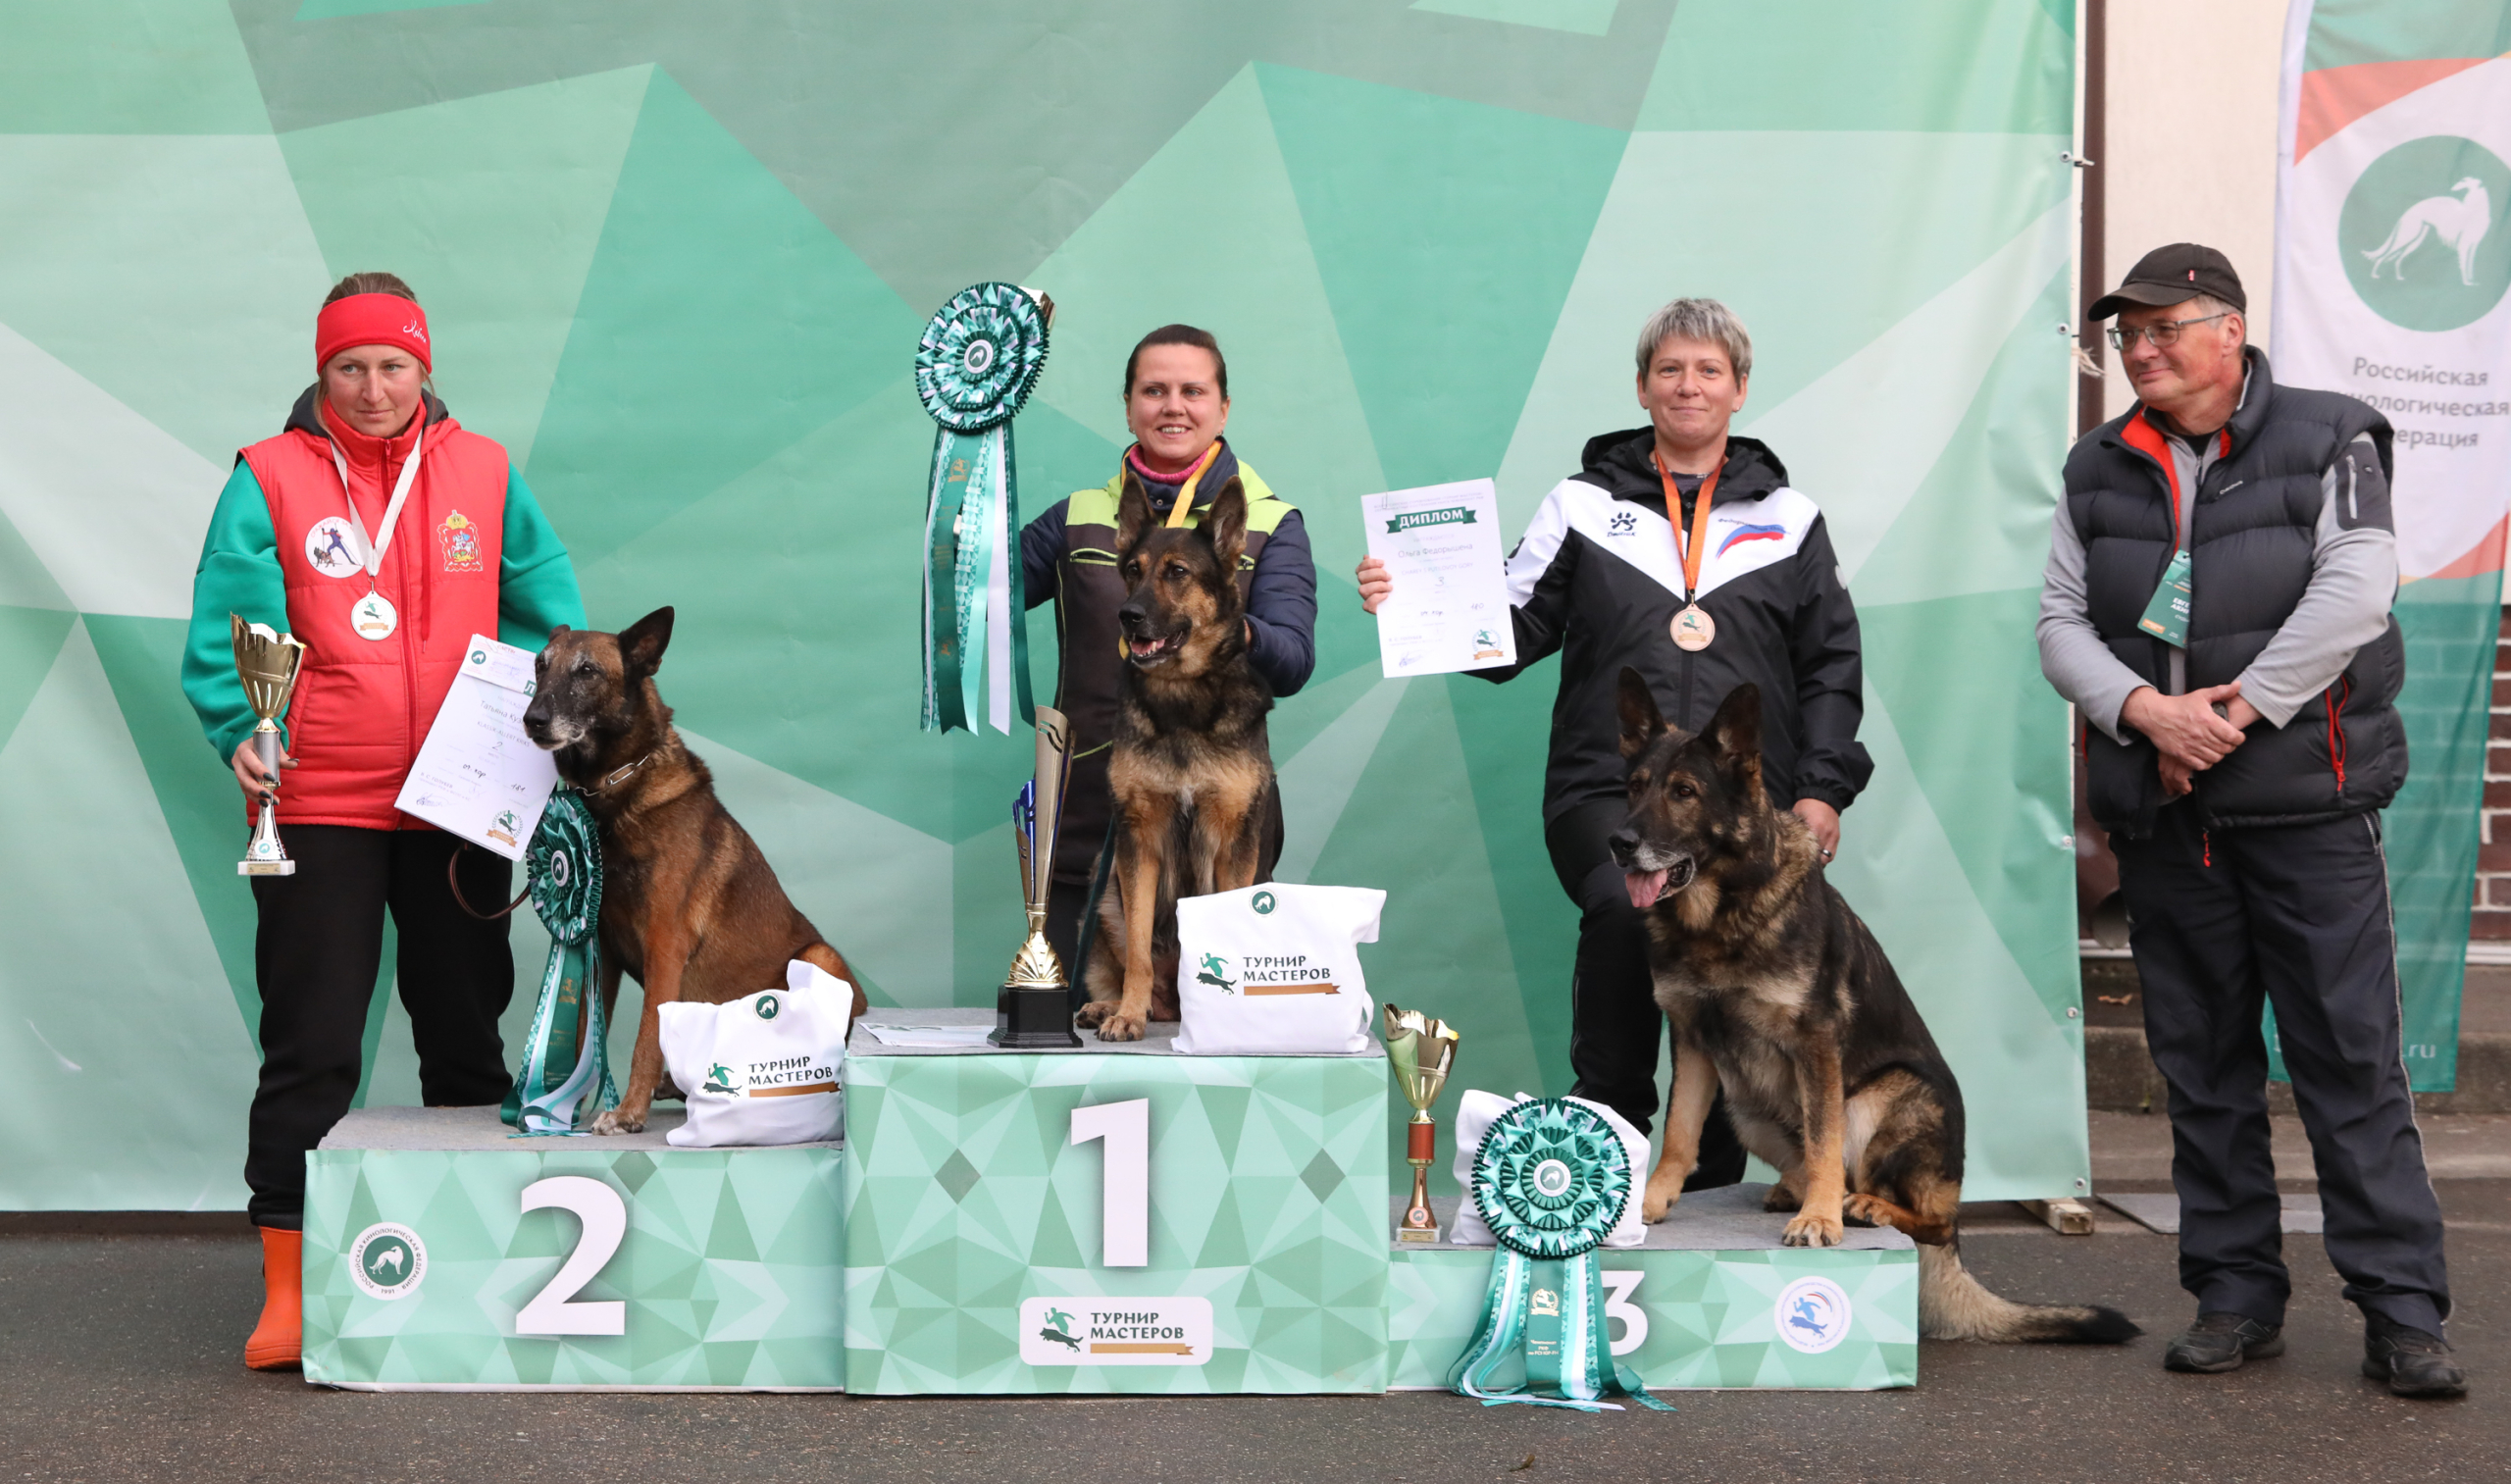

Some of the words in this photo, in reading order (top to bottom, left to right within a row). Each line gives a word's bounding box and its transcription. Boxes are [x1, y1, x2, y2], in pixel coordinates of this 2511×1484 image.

[2353, 357, 2488, 385] Российская
[2342, 392, 2510, 417] ологическая
[2395, 429, 2480, 450] ерация
[1399, 509, 1463, 529] ДИПЛОМ
[1422, 543, 1473, 555] Федорышена
[481, 700, 507, 718] Татьяна
[509, 713, 524, 725] Куз
[491, 742, 503, 751] 2
[1243, 955, 1307, 968] ТУРНИР
[1243, 968, 1331, 982] МАСТЕРОВ
[748, 1056, 810, 1073] ТУРНИР
[748, 1066, 833, 1085] МАСТЕРОВ
[1071, 1098, 1149, 1266] 1
[362, 1228, 420, 1252] КИНОЛОГИЧЕСКАЯ
[516, 1175, 626, 1335] 2
[355, 1244, 374, 1289] РОССИЙСКАЯ
[401, 1253, 422, 1290] ФЕДЕРАЦИЯ
[1091, 1312, 1159, 1324] ТУРНИР
[1600, 1270, 1648, 1356] 3
[1091, 1327, 1184, 1339] МАСТЕРОВ
